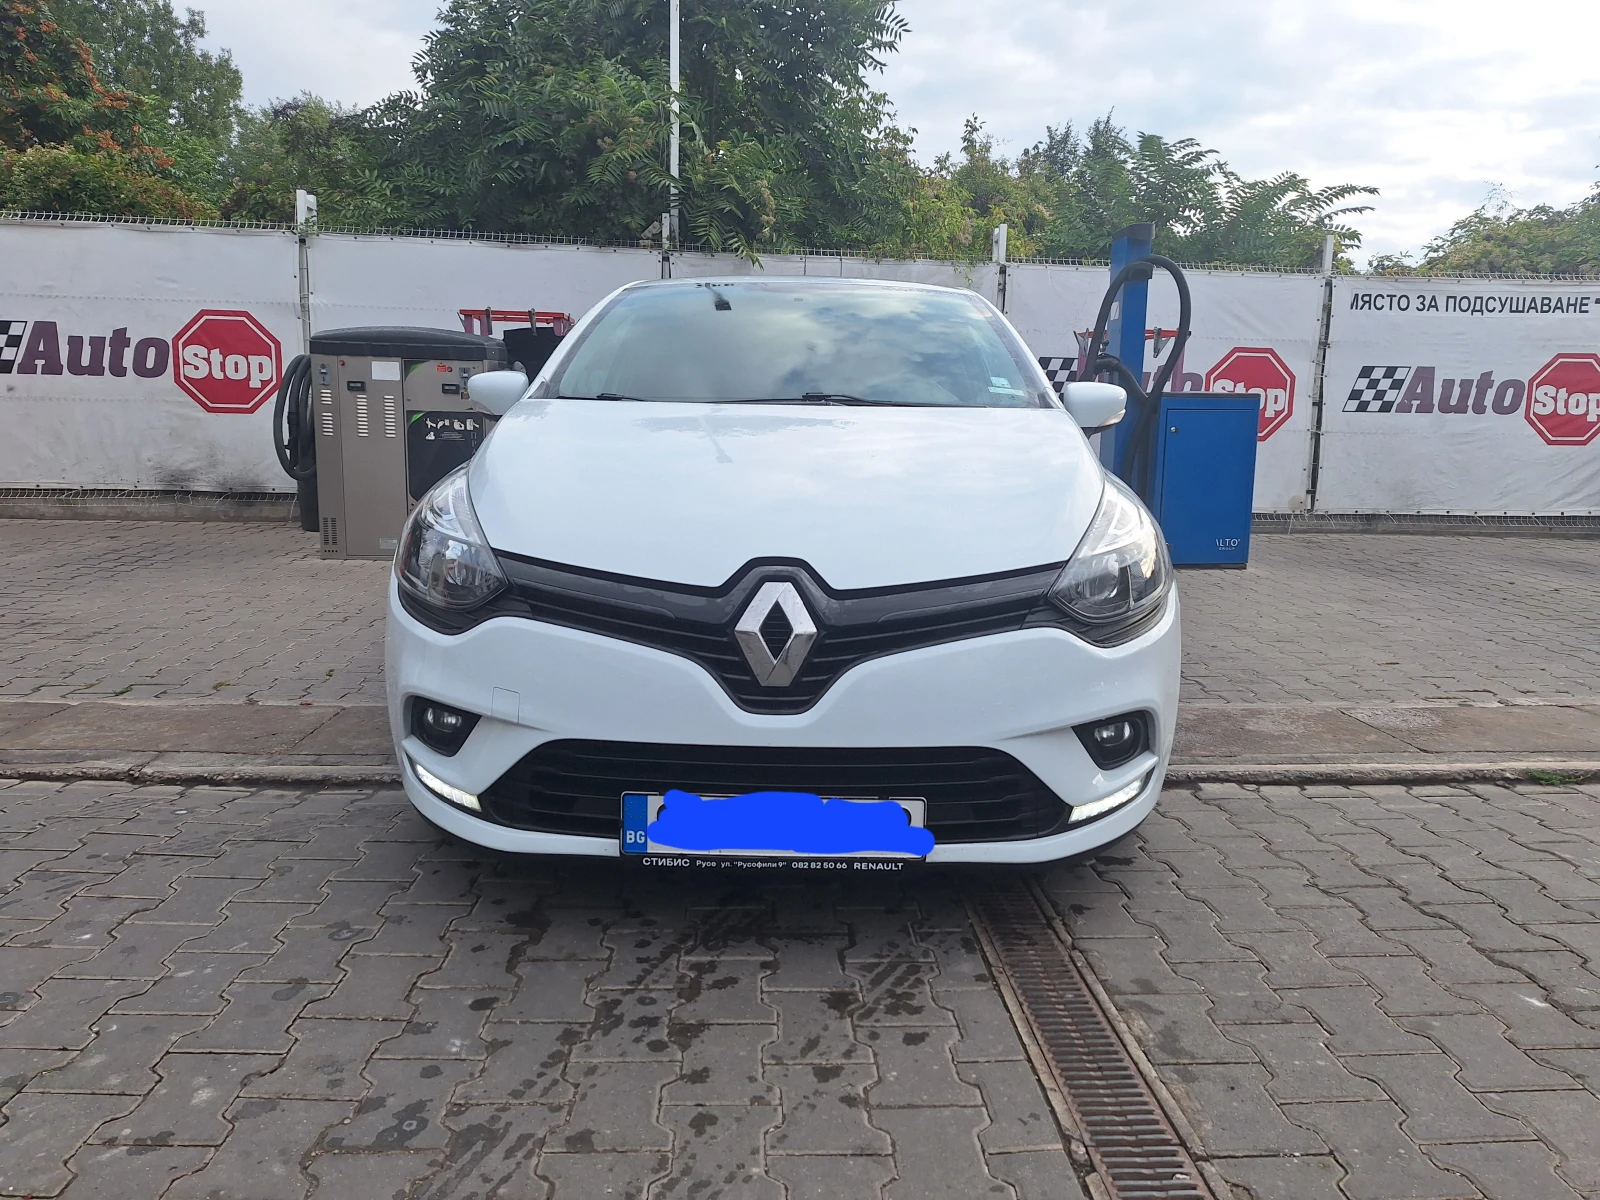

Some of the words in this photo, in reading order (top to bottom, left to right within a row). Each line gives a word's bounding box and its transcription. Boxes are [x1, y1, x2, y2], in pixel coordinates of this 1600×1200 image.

[1416, 294, 1439, 312] ЗА
[1445, 295, 1591, 316] ПОДСУШАВАНЕ
[17, 321, 170, 378] Auto
[183, 345, 272, 388] Stop
[1395, 366, 1526, 415] Auto
[626, 830, 645, 844] BG
[642, 857, 690, 867] СТИБИС
[853, 862, 904, 870] RENAULT
